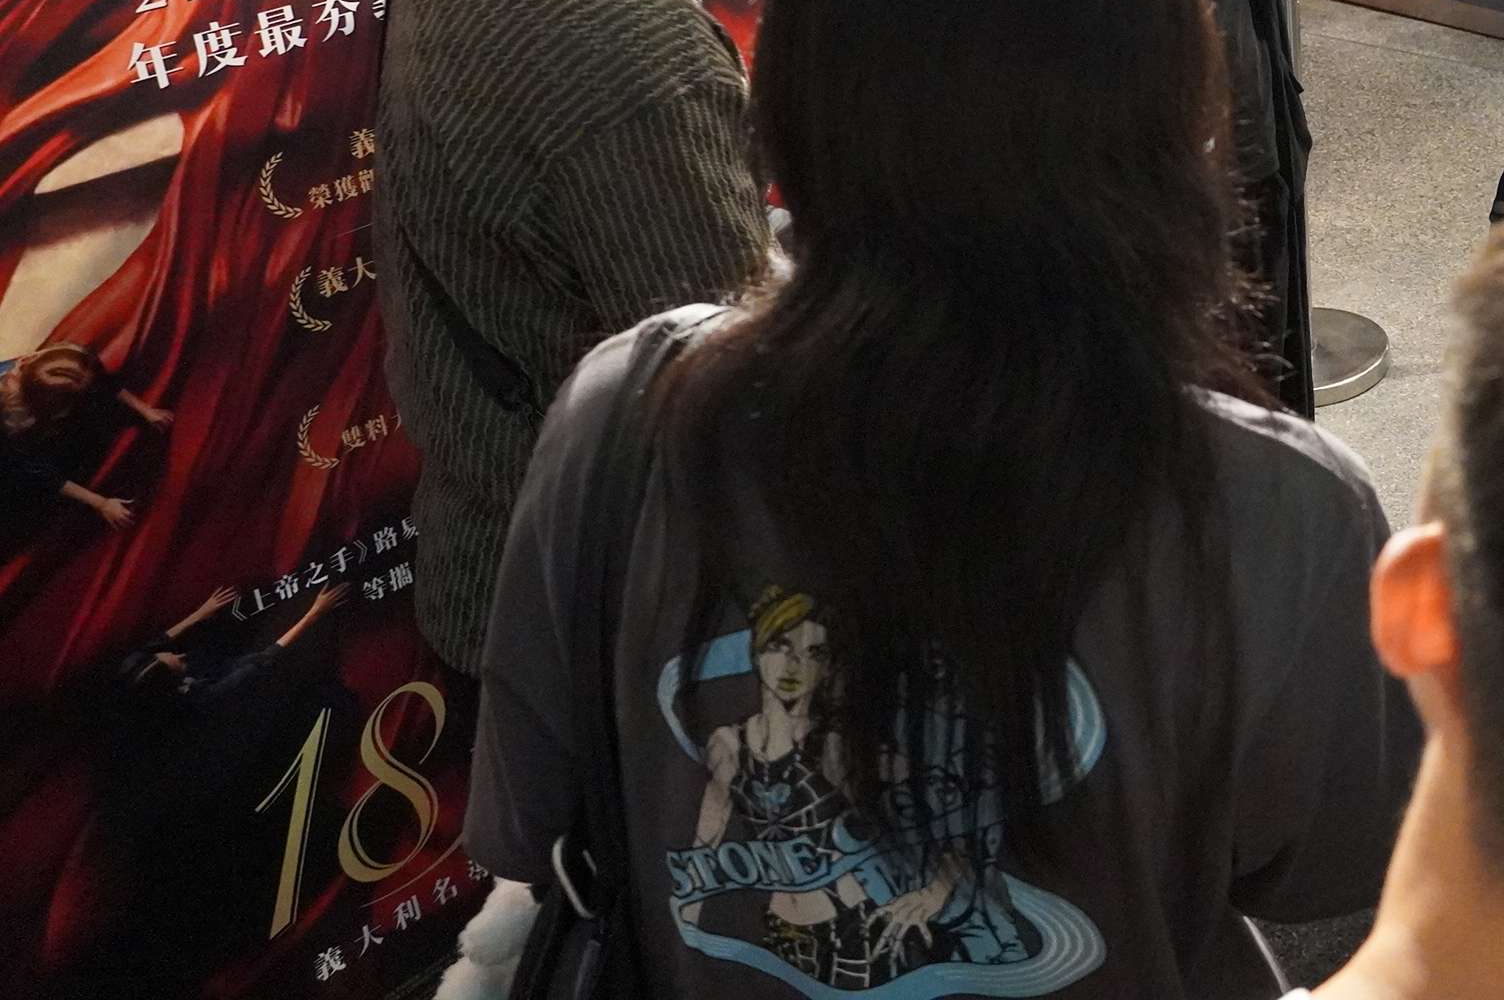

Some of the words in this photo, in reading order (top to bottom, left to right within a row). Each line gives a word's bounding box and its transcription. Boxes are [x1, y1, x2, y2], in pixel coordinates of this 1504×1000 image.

[317, 256, 377, 299] 義大
[254, 681, 446, 941] 18
[666, 836, 831, 899] STONE
